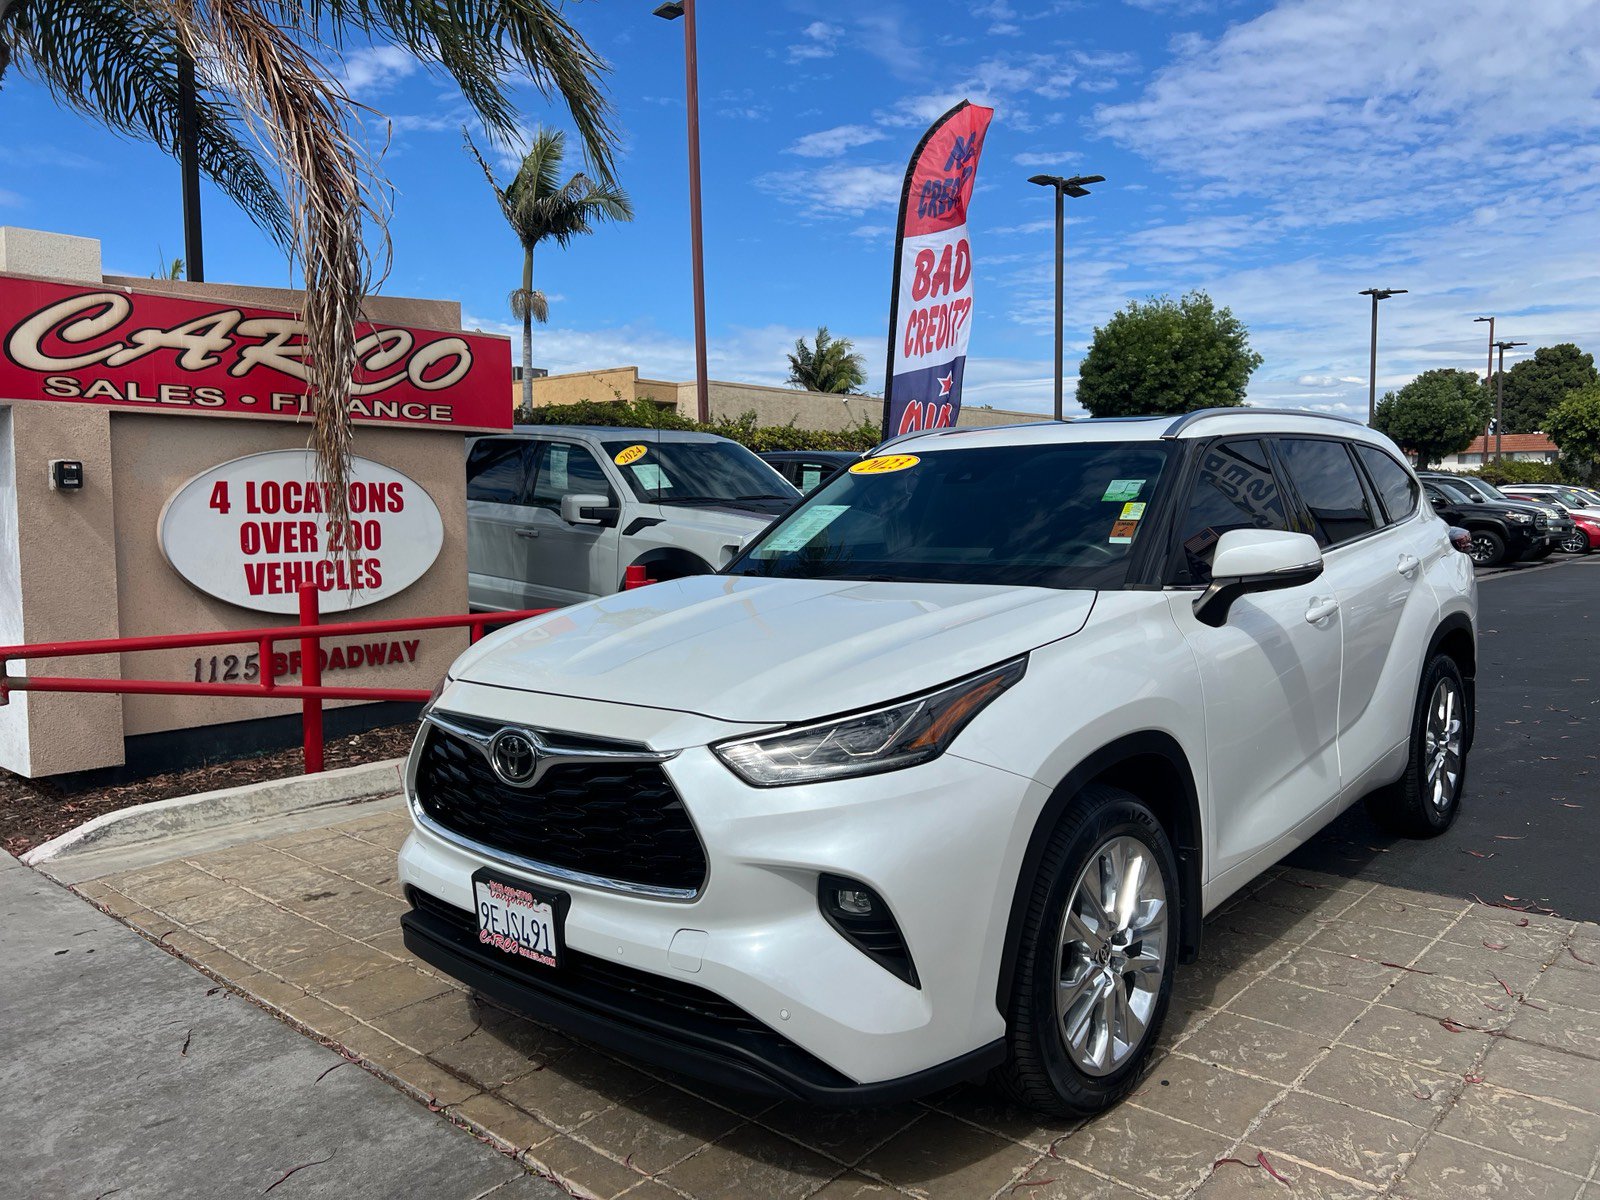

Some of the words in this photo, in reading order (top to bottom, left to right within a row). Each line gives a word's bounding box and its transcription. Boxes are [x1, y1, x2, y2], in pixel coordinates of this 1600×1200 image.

[911, 238, 971, 302] BAD
[3, 291, 473, 396] CARCO
[904, 297, 972, 359] CREDIT?
[43, 376, 225, 407] SALES
[271, 392, 453, 422] FIANCE
[620, 446, 642, 463] 2024
[209, 481, 231, 514] 4
[240, 521, 319, 556] OVER
[325, 520, 382, 551] 200
[244, 558, 383, 596] VEHICLES
[194, 652, 260, 683] 1125
[479, 929, 519, 954] CARCO
[481, 901, 552, 956] 9EJS491
